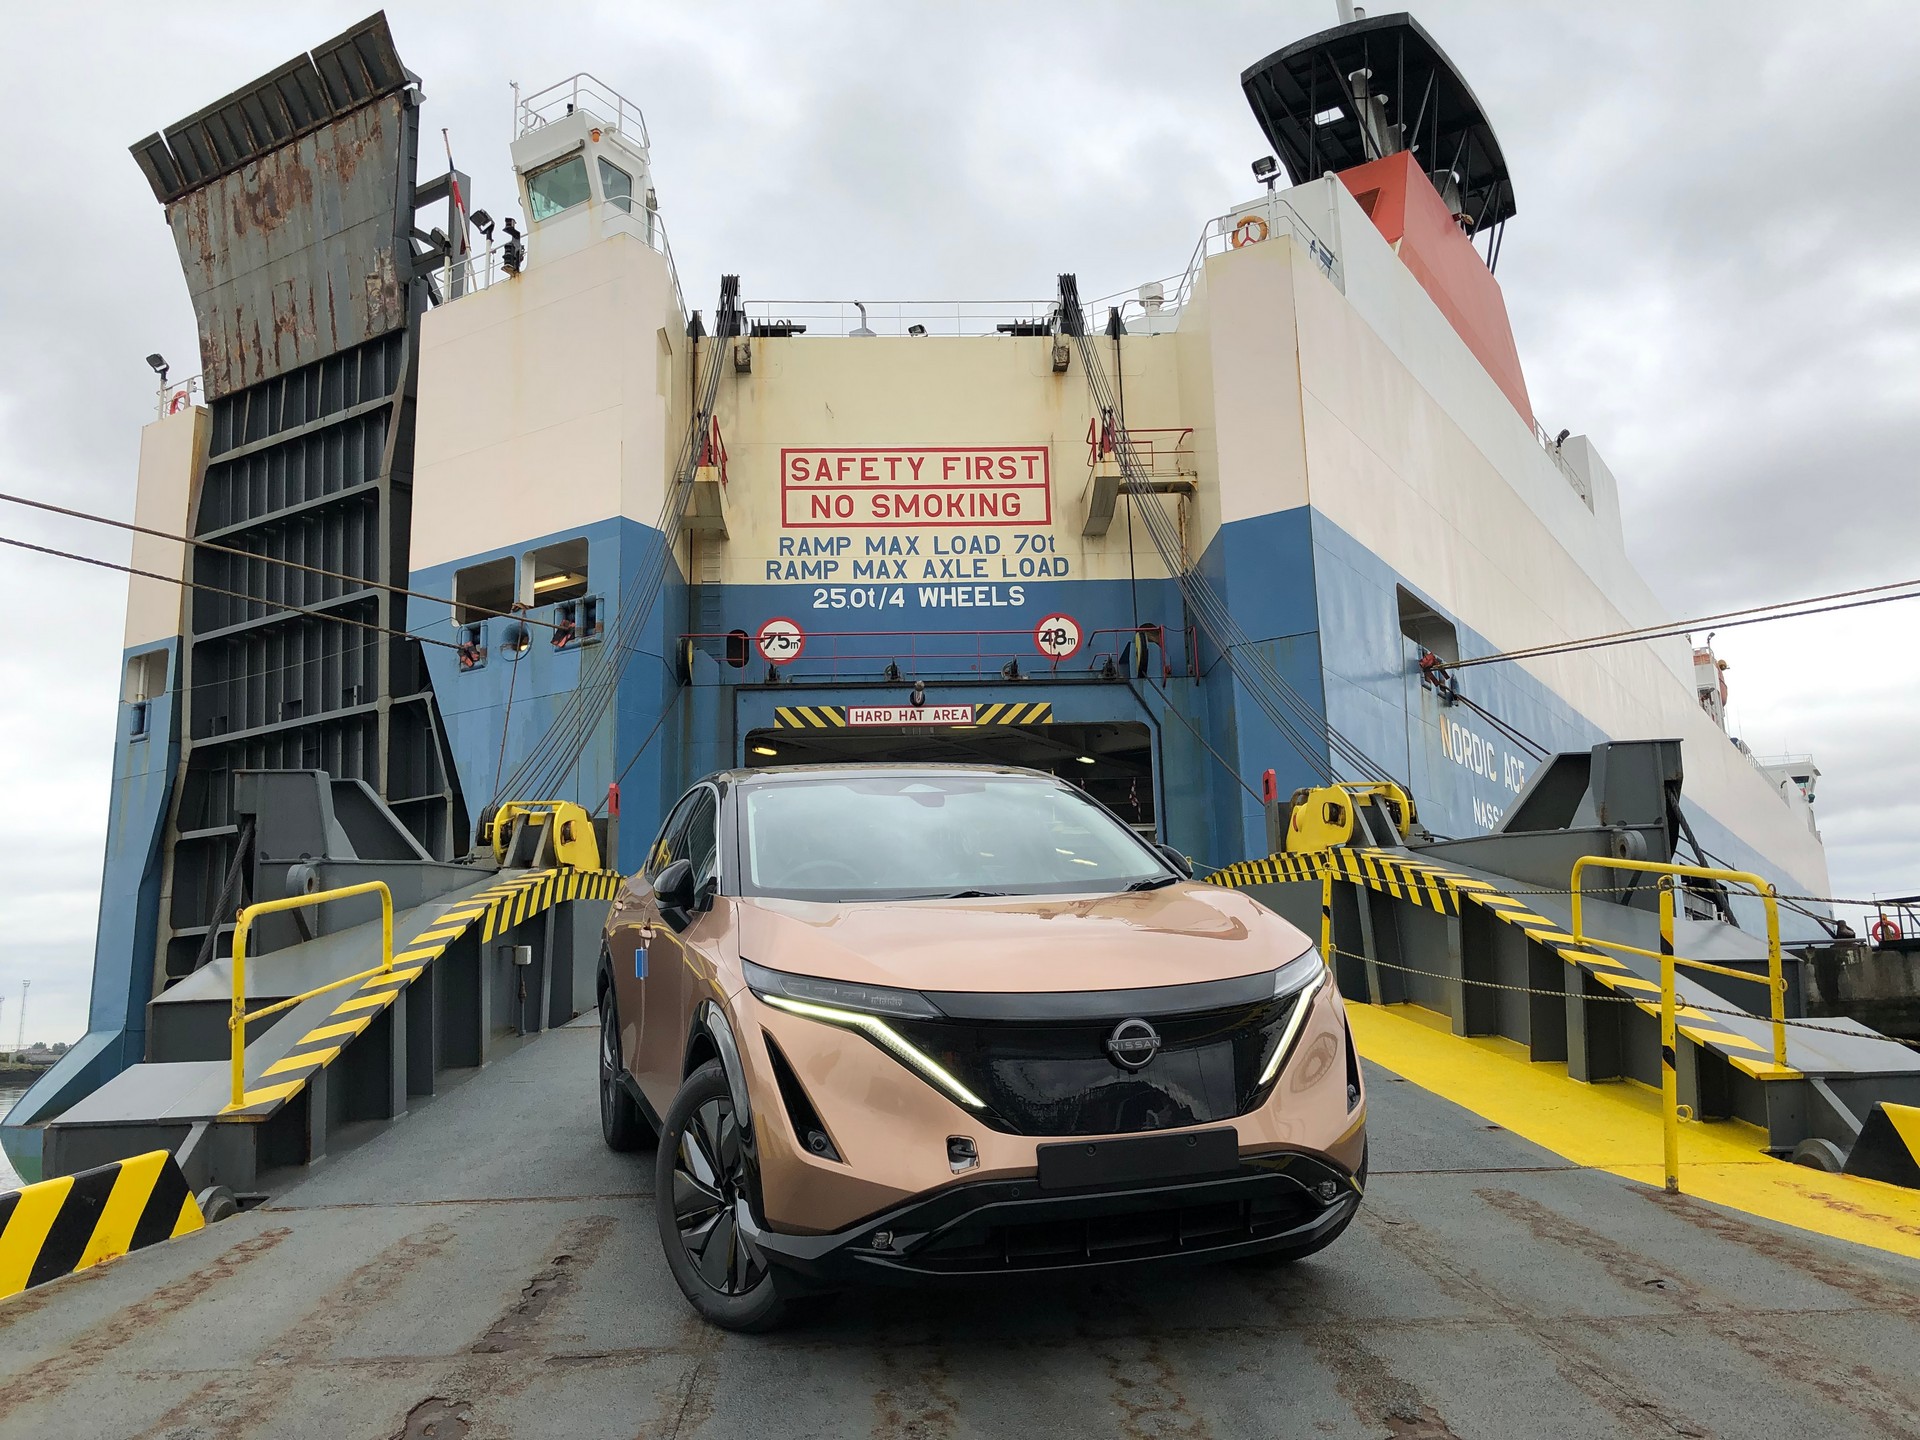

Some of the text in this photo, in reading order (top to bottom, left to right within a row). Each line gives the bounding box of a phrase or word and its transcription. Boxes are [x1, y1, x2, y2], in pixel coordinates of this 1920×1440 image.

[791, 455, 1039, 481] SAFETY FIRST
[811, 492, 1021, 519] NO SMOKING
[779, 534, 1055, 556] RAMP MAX LOAD 70t
[766, 557, 1070, 580] RAMP MAX AXLE LOAD
[918, 585, 1025, 608] WHEELS
[855, 709, 969, 722] HARD HAT AREA
[1440, 714, 1497, 782] NORDIC
[1472, 796, 1503, 830] NASS
[1109, 1039, 1160, 1051] NISSAN
